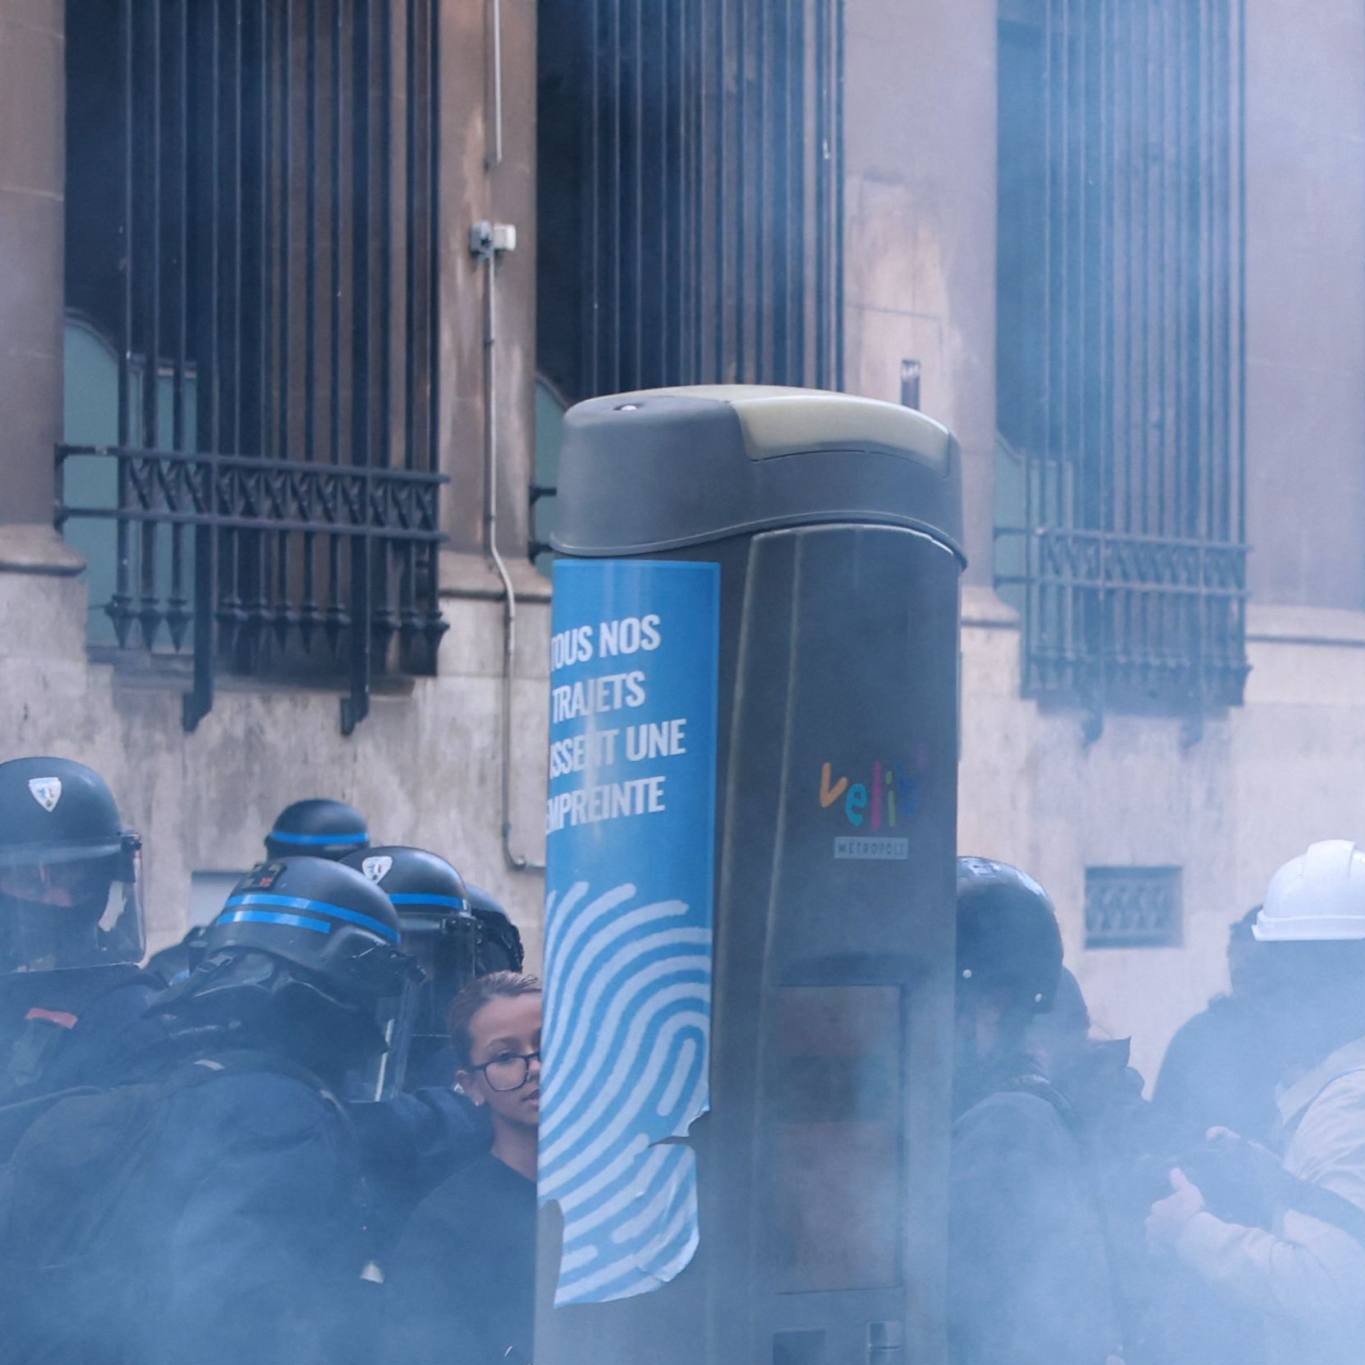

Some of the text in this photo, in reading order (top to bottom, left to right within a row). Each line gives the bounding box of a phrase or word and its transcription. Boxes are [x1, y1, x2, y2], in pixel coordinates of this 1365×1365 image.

[599, 613, 661, 658] NOS
[552, 670, 646, 724] TRAJETS
[625, 718, 687, 762] UNE
